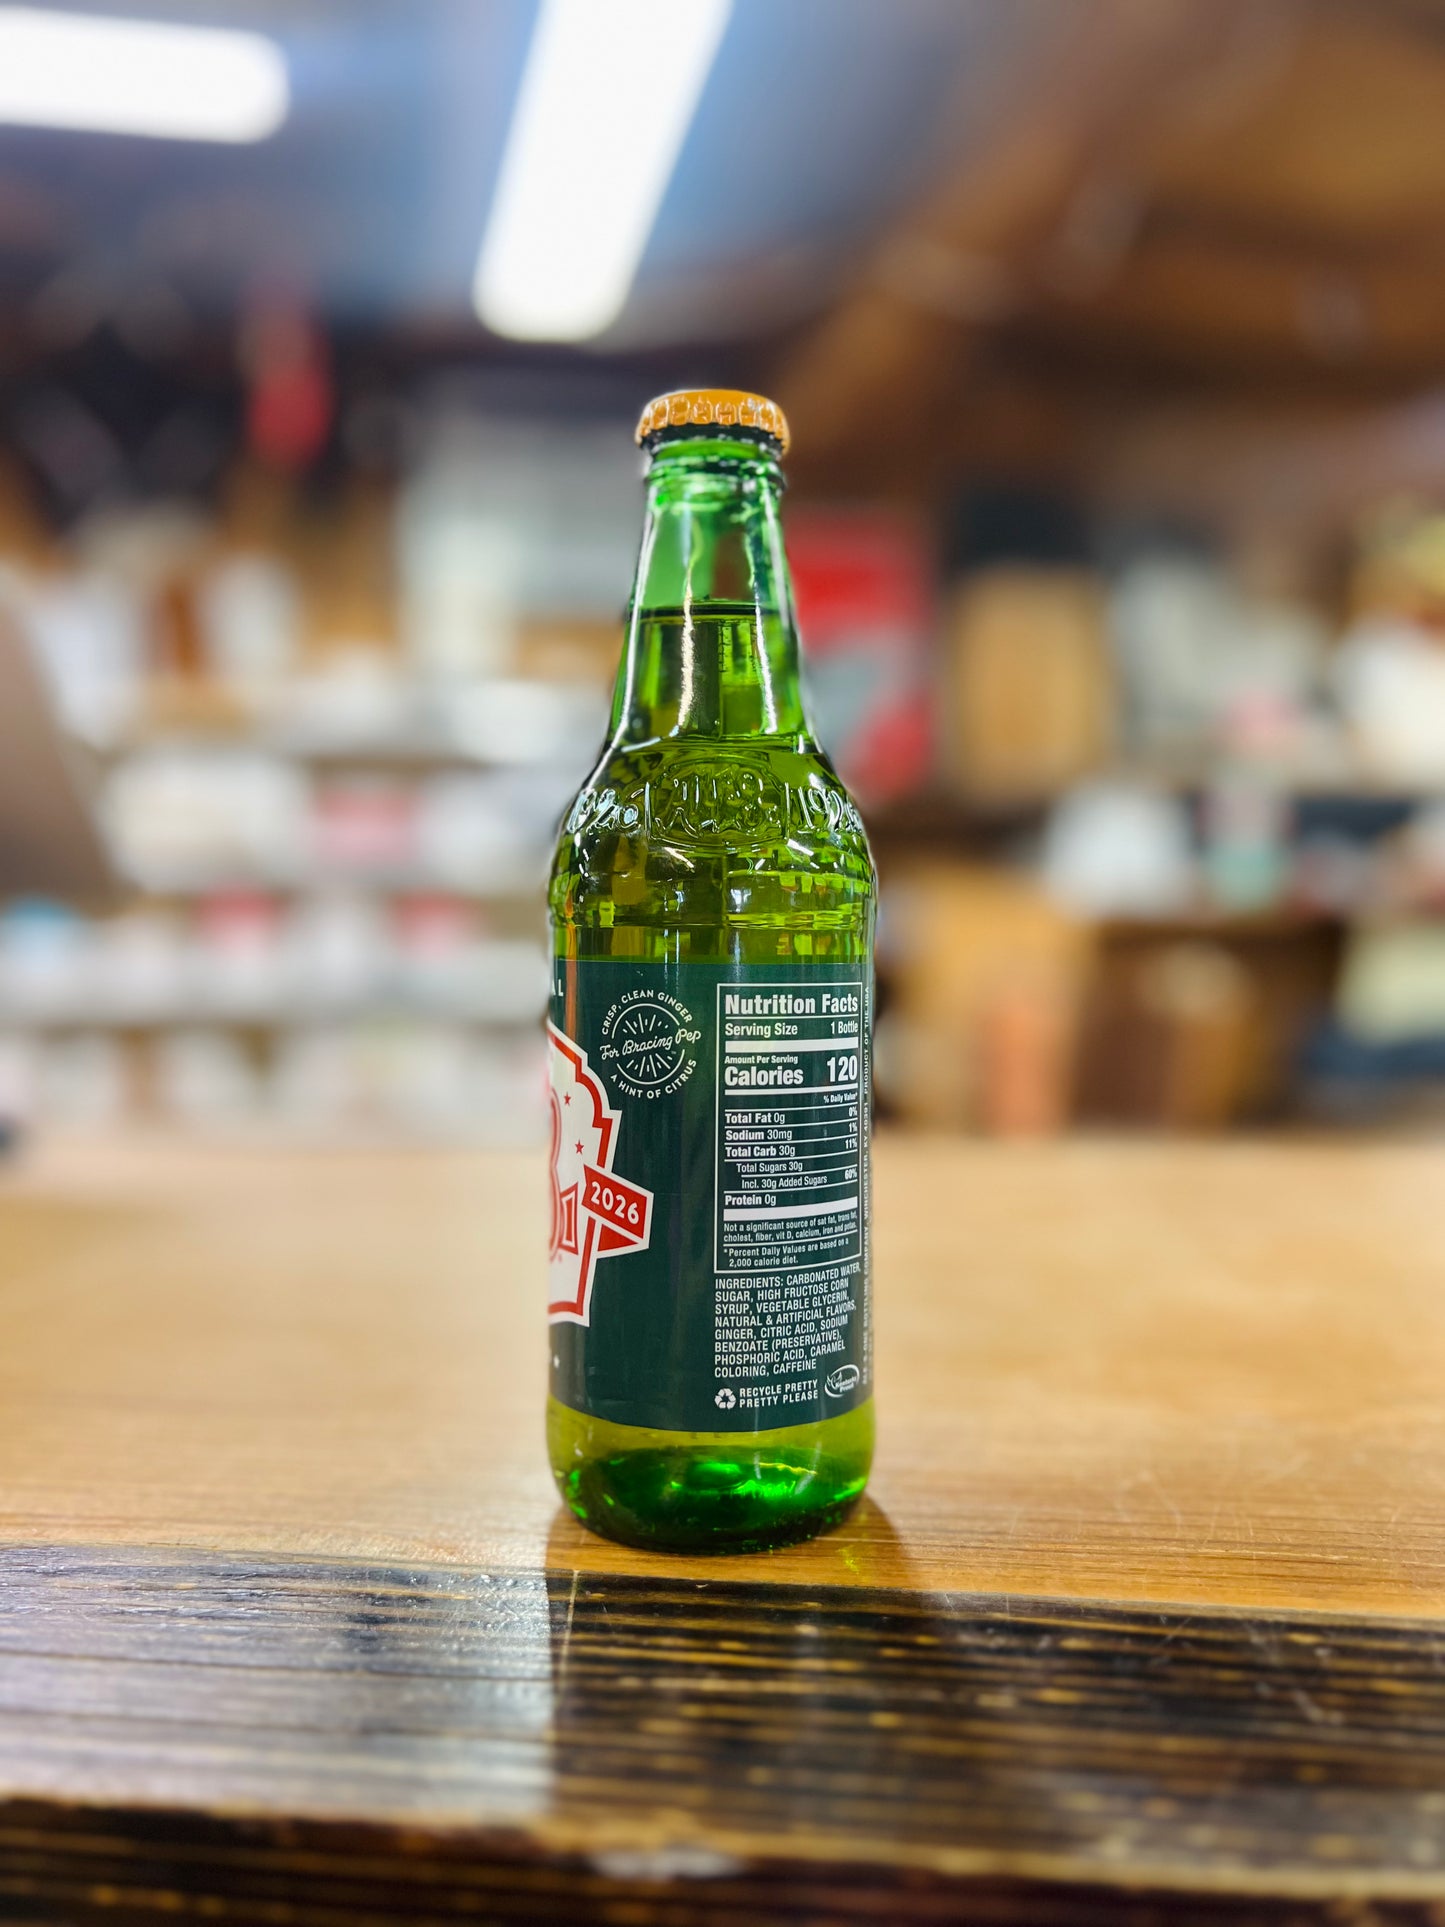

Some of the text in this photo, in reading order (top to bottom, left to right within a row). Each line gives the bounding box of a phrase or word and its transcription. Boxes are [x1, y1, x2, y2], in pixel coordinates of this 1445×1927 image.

[602, 990, 692, 1035] CRISP, CLEAN GINGER
[725, 994, 858, 1015] Nutrition Facts
[725, 1021, 858, 1037] Serving Size 1 Bottle
[600, 1028, 701, 1060] For Bracing Pep
[864, 1034, 869, 1045] OF
[725, 1056, 755, 1064] Amount
[771, 1055, 798, 1063] Serving
[610, 1060, 696, 1099] A HINT OF CITRUS
[725, 1056, 857, 1086] Calories 120
[831, 1095, 843, 1103] Daily
[726, 1107, 857, 1124] Total Fat 0g 0%
[726, 1123, 857, 1140] Sodium 30mg 1%
[726, 1139, 857, 1156] Total Carb 30g 11%
[736, 1162, 802, 1173] Total Sugars 30g
[742, 1169, 857, 1189] Incl. 30g Added Sugars 60%
[590, 1180, 640, 1226] 2026
[725, 1195, 776, 1206] Protein 0g
[746, 1222, 784, 1232] significant
[786, 1220, 808, 1228] source
[828, 1216, 836, 1224] fat,
[838, 1214, 850, 1222] trans
[724, 1234, 753, 1242] cholest,
[756, 1233, 774, 1241] fiber,
[786, 1232, 794, 1240] D,
[796, 1229, 821, 1239] calcium,
[834, 1226, 843, 1234] and
[762, 1247, 781, 1256] Daily
[783, 1245, 805, 1253] Values
[820, 1240, 836, 1250] based
[729, 1256, 798, 1268] 2,000 calorie diet.
[715, 1262, 861, 1289] INGREDIENTS: CARBONATED WATER,
[715, 1278, 849, 1302] SUGAR, HIGH FRUCTOSE CORN
[715, 1290, 849, 1315] SYRUP, VEGETABLE GLYCERIN,
[715, 1300, 856, 1327] NATURAL & ARTIFICIAL FLAVORS,
[715, 1315, 848, 1340] GINGER, CITRIC ACID, SODIUM
[715, 1329, 841, 1352] BENZOATE (PRESERVATIVE),
[715, 1340, 845, 1365] PHOSPHORIC ACID, CARAMEL
[715, 1359, 816, 1378] COLORING, CAFFEINE
[740, 1380, 818, 1397] RECYCLE PRETTY
[740, 1390, 818, 1407] PRETTY PLEASE
